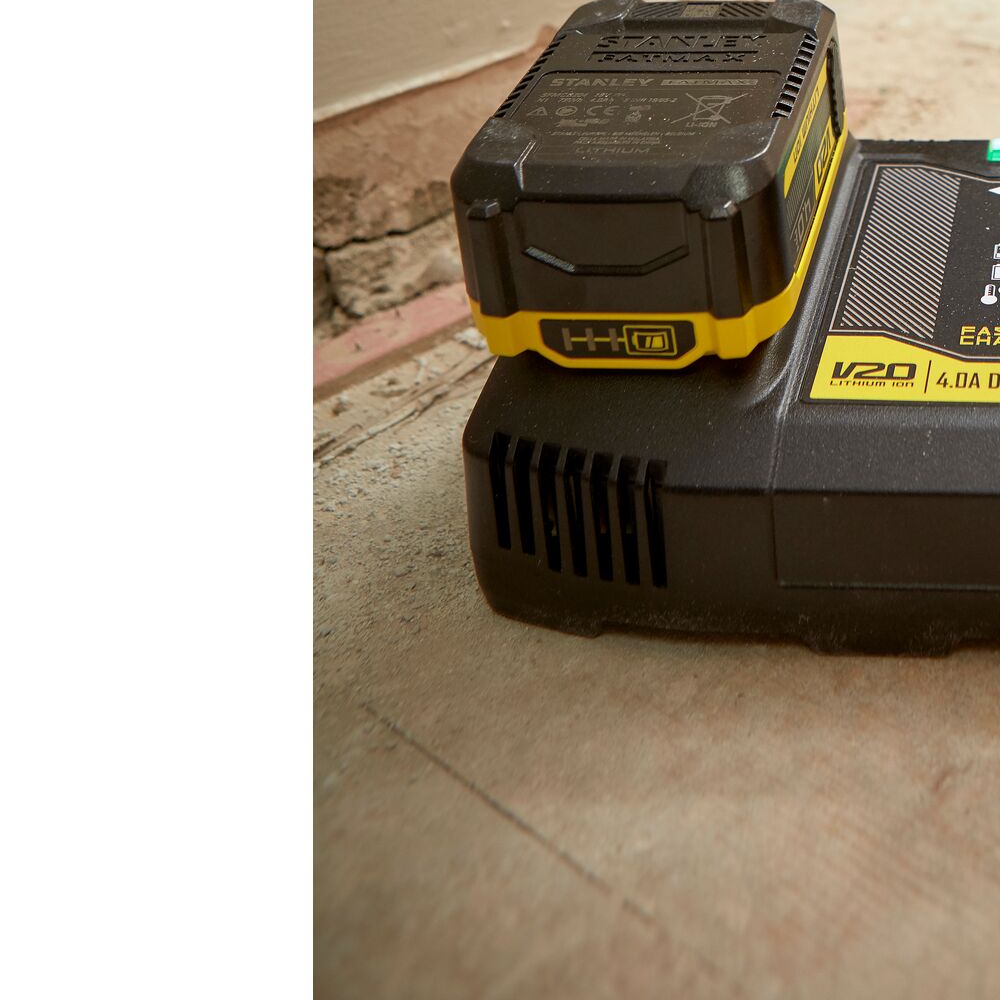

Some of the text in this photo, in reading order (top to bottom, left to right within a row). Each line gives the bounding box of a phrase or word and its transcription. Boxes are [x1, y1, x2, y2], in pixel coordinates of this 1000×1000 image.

[597, 35, 767, 48] STANLEY
[598, 54, 746, 63] FATMAX
[550, 78, 655, 87] STANLEY
[831, 362, 917, 379] V20
[936, 372, 981, 389] 4.0A
